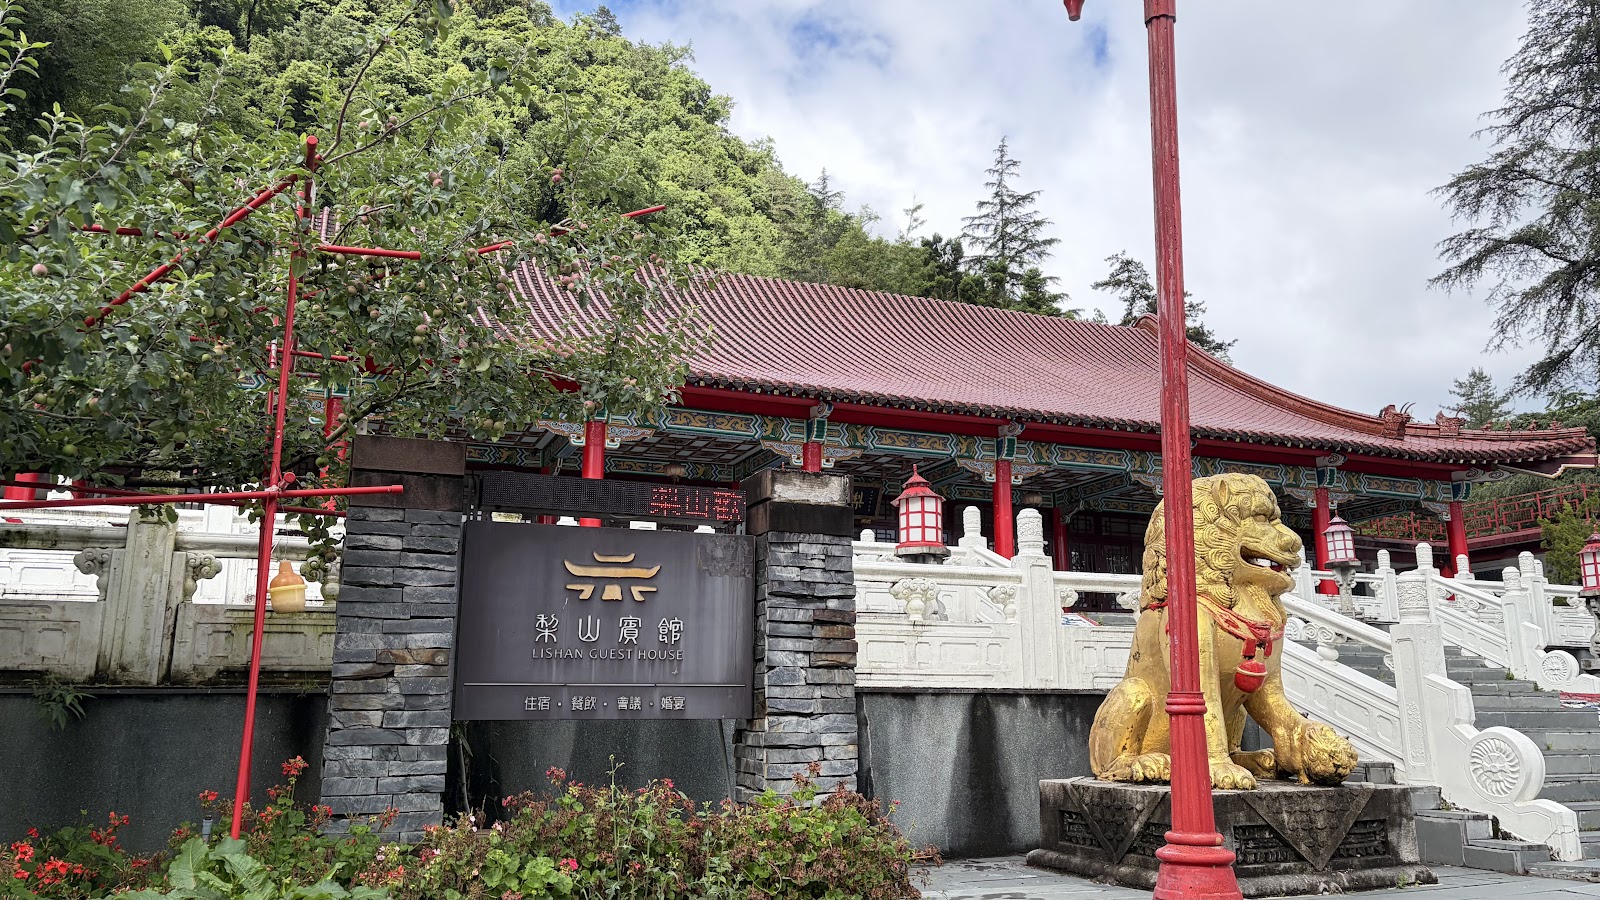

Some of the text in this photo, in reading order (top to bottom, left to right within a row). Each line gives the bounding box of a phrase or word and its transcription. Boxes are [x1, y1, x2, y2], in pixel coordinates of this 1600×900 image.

[535, 613, 684, 645] 梨山賓館
[532, 648, 684, 660] LISHAN GUEST HOUSE
[524, 696, 686, 711] 住宿 餐飲 會議 婚宴
